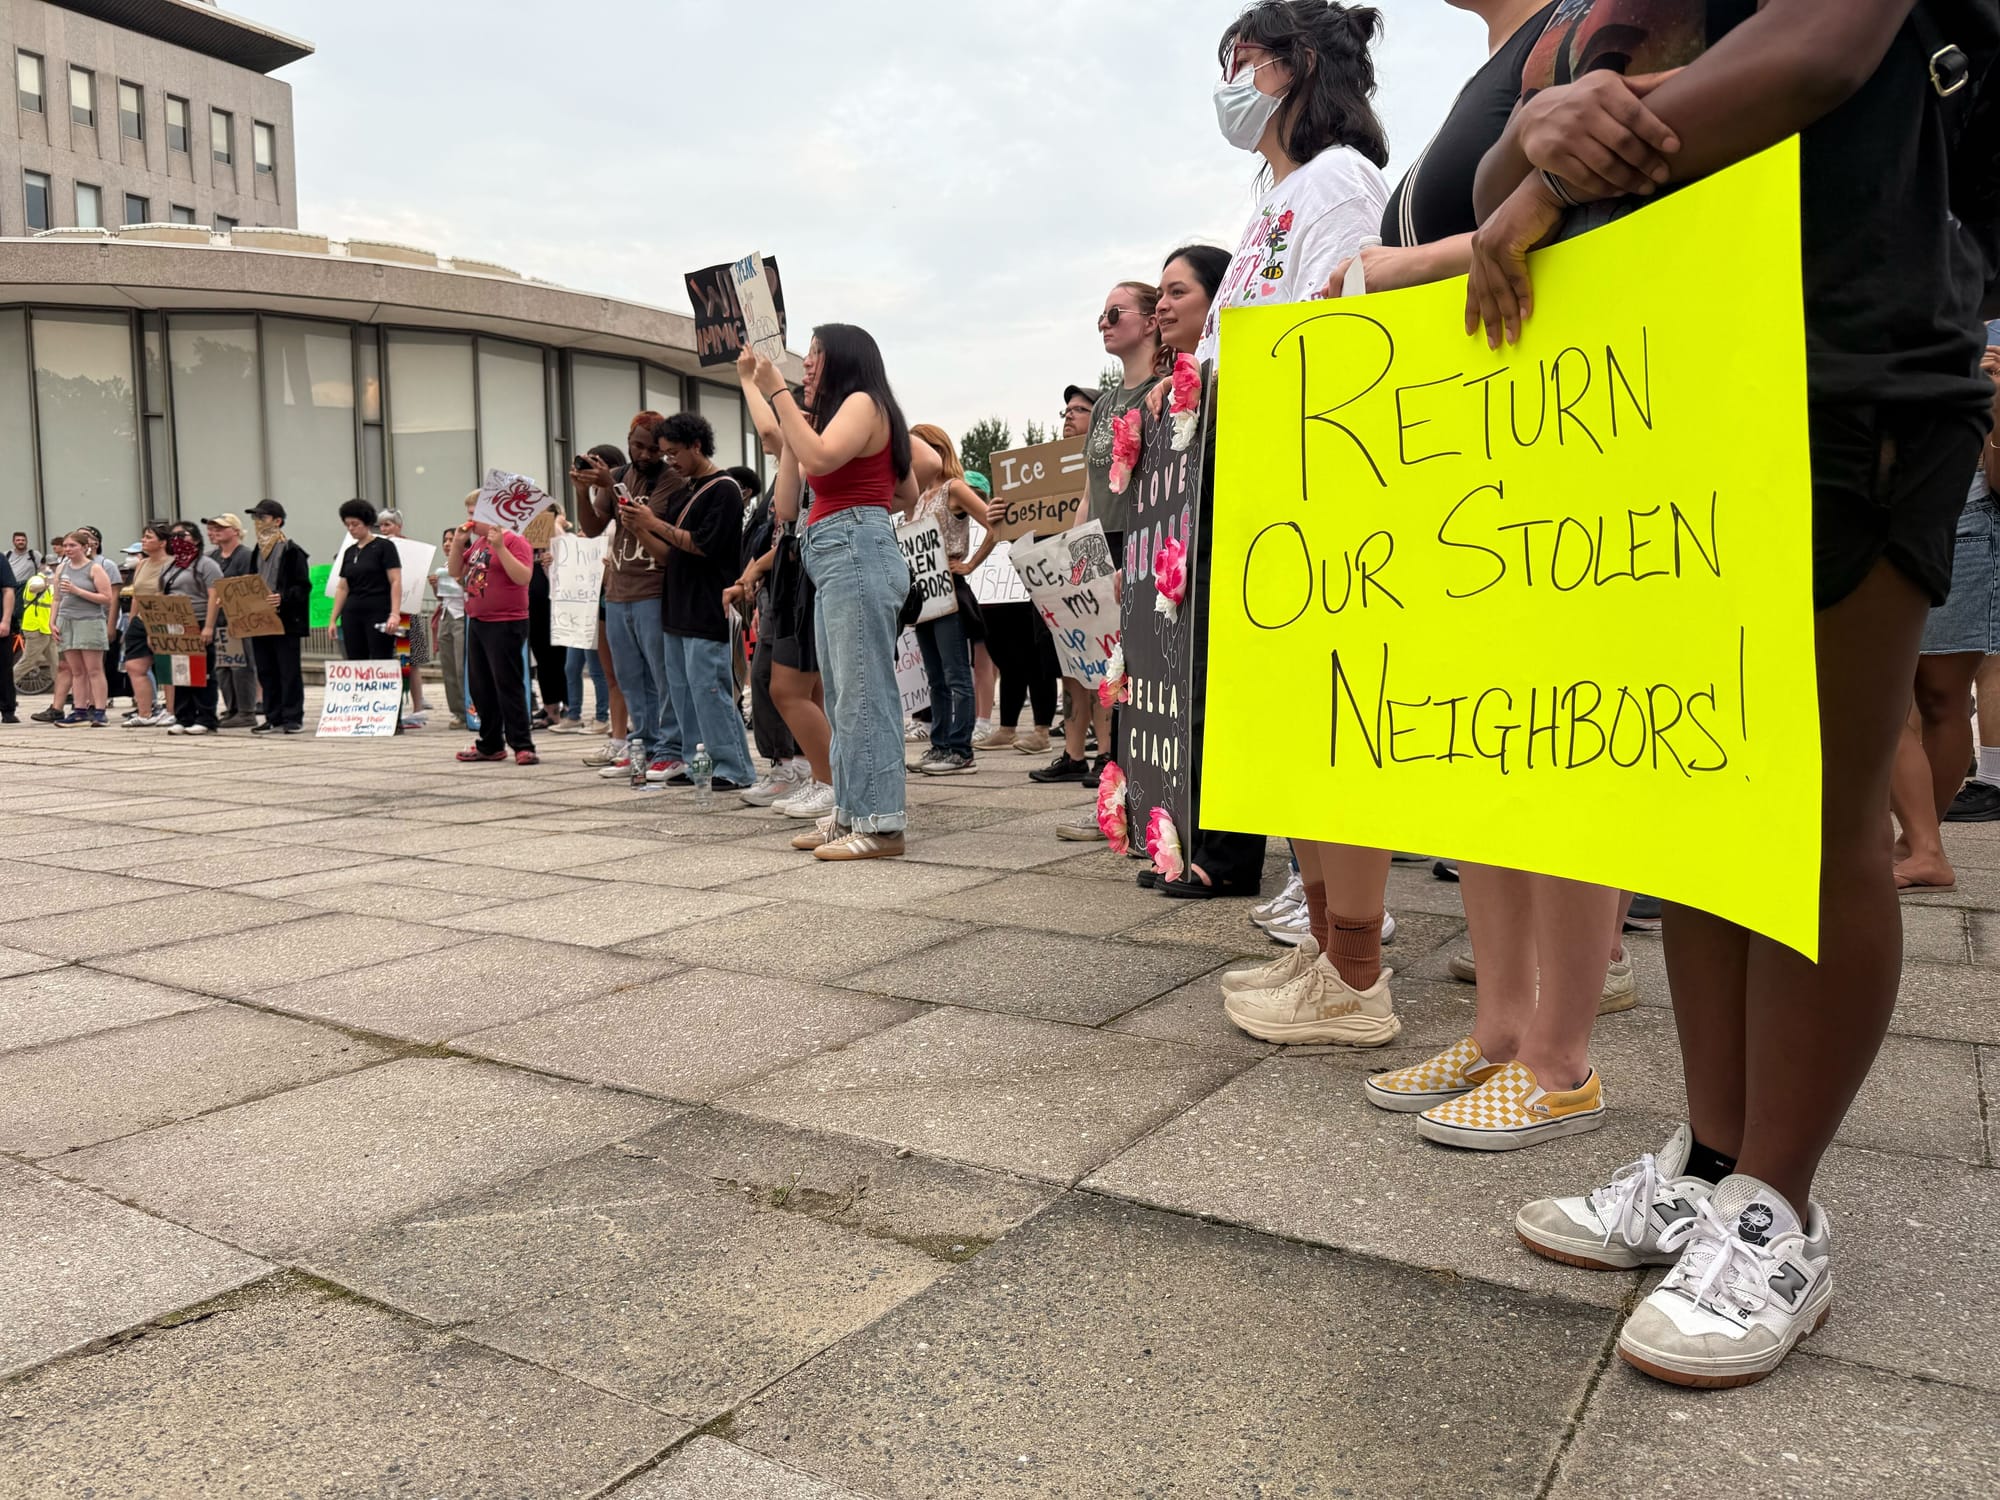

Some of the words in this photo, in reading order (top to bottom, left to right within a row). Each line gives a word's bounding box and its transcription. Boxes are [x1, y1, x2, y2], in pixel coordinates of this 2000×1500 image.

[1272, 311, 1653, 500] RETURN
[1000, 458, 1045, 491] Ice
[1137, 453, 1188, 513] LOVE
[1004, 497, 1080, 526] Gestapo
[915, 529, 941, 554] OUR
[1243, 521, 1404, 630] OUR
[1438, 480, 1721, 599] STOLEN
[918, 570, 953, 603] BORS
[1017, 558, 1065, 592] CE,
[1062, 588, 1099, 618] my
[150, 637, 182, 652] FUCK
[329, 665, 351, 679] 200
[329, 681, 351, 692] 700
[1127, 676, 1178, 719] BELLA
[1331, 625, 1751, 782] NEIGHBORS!
[1130, 727, 1178, 788] CIAO!
[1316, 999, 1362, 1020] HOKA
